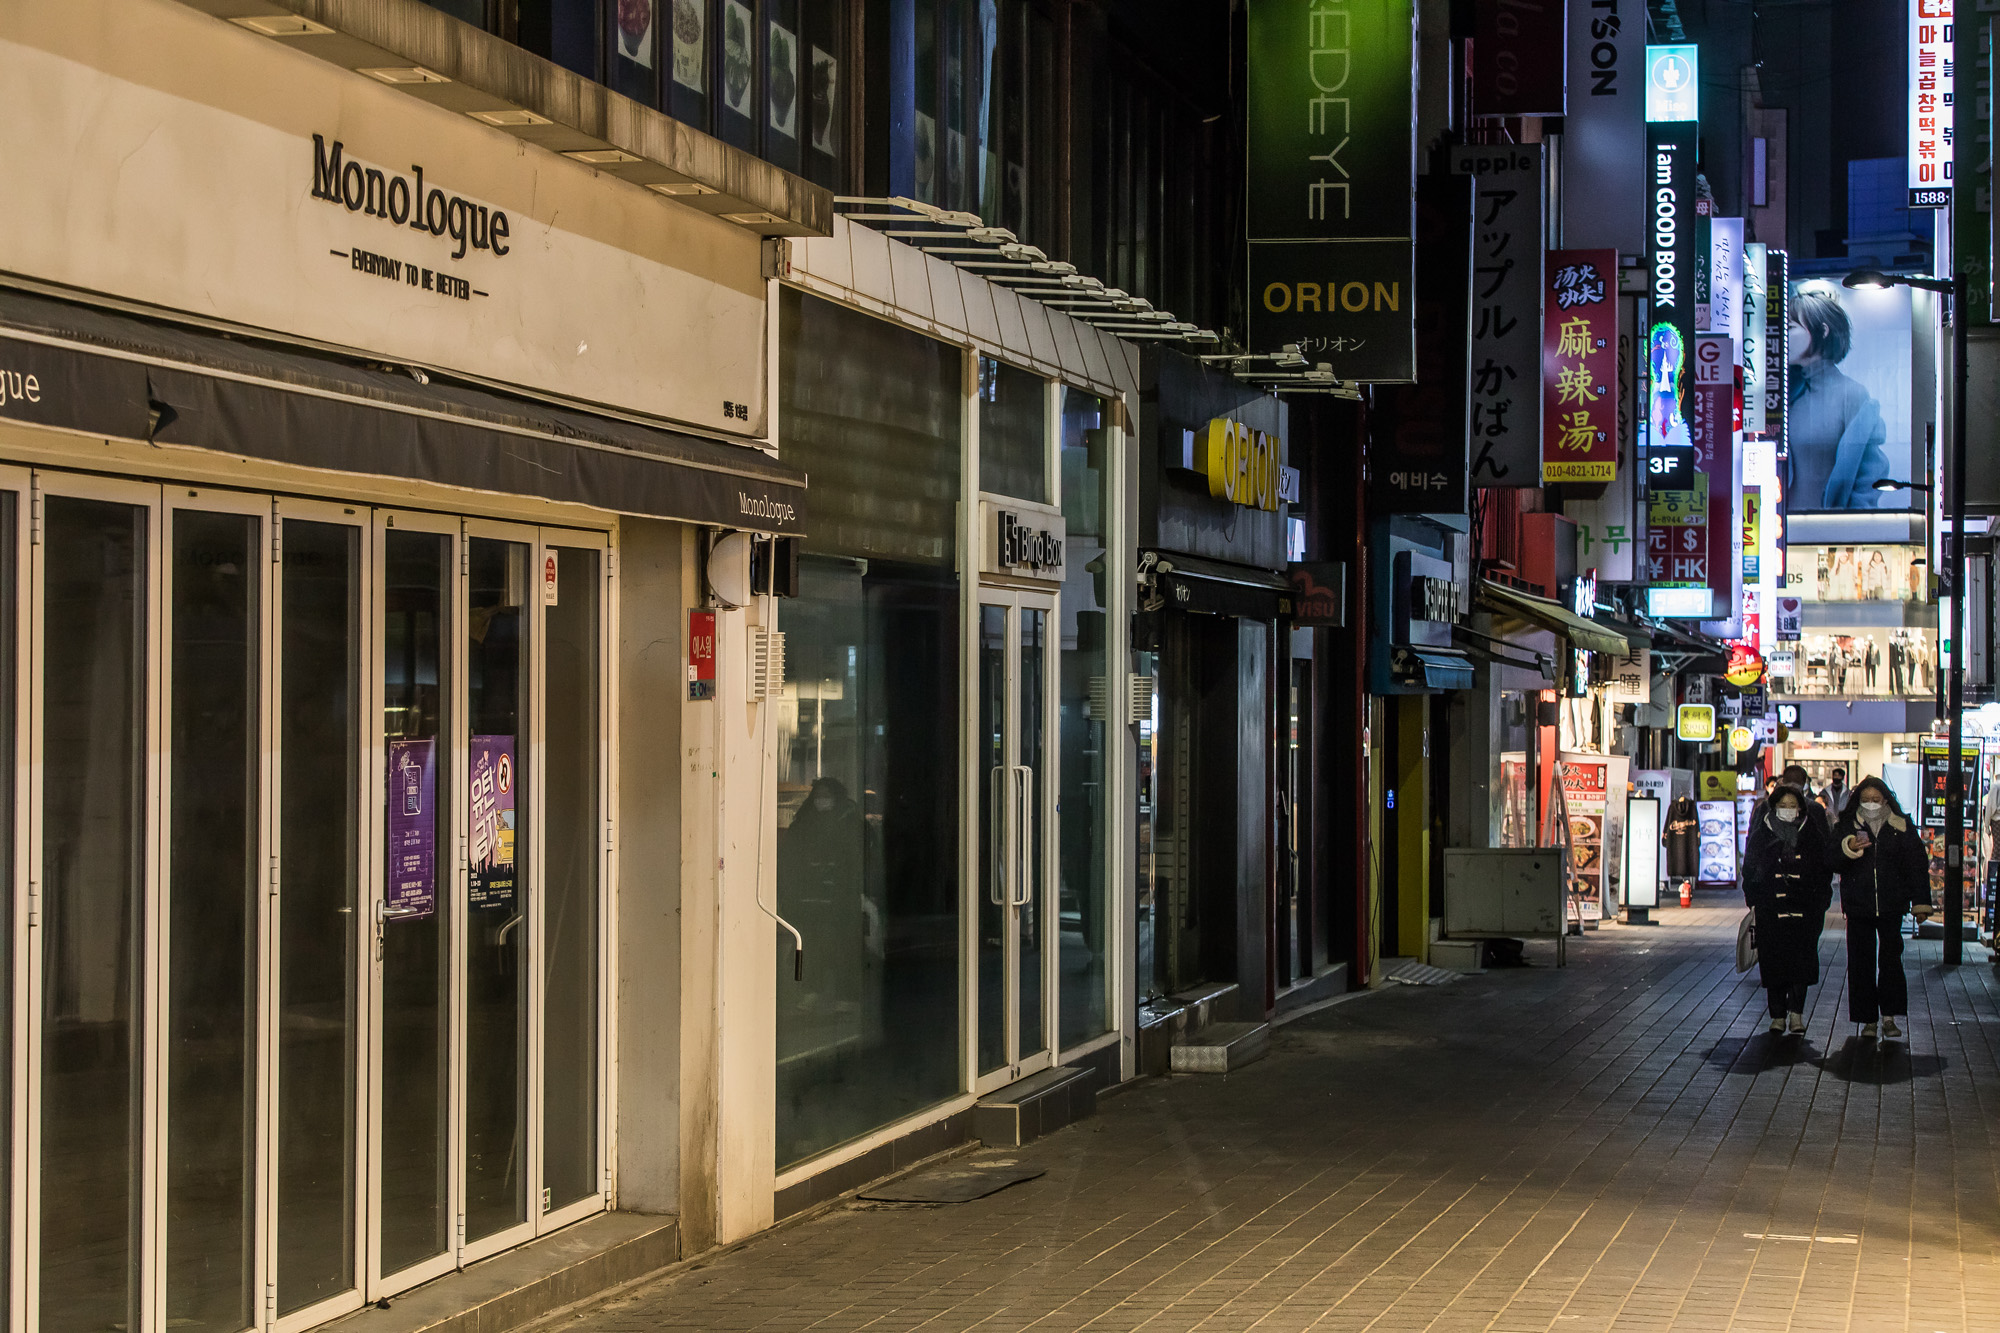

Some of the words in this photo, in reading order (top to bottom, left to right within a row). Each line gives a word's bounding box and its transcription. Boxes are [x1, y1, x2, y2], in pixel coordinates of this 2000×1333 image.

[1309, 0, 1350, 220] EDEYE
[1918, 25, 1937, 183] 마늘곱창떡볶이
[1460, 152, 1531, 176] apple
[1657, 154, 1672, 185] am
[312, 133, 510, 259] Monologue
[1656, 187, 1676, 248] GOOD
[352, 248, 401, 281] EVERYDAY
[405, 263, 418, 286] TO
[421, 268, 434, 291] BE
[436, 272, 470, 300] BETTER
[1656, 251, 1675, 307] BOOK
[1263, 281, 1399, 313] ORION
[1296, 336, 1366, 352] オリオン
[1554, 316, 1599, 453] 麻辣湯
[1213, 417, 1281, 512] ORION
[1390, 471, 1448, 490] 에비수
[1546, 464, 1611, 478] 010-4821-1714
[1650, 457, 1679, 473] 3F
[739, 491, 796, 525] Monologue
[1675, 558, 1705, 578] HK
